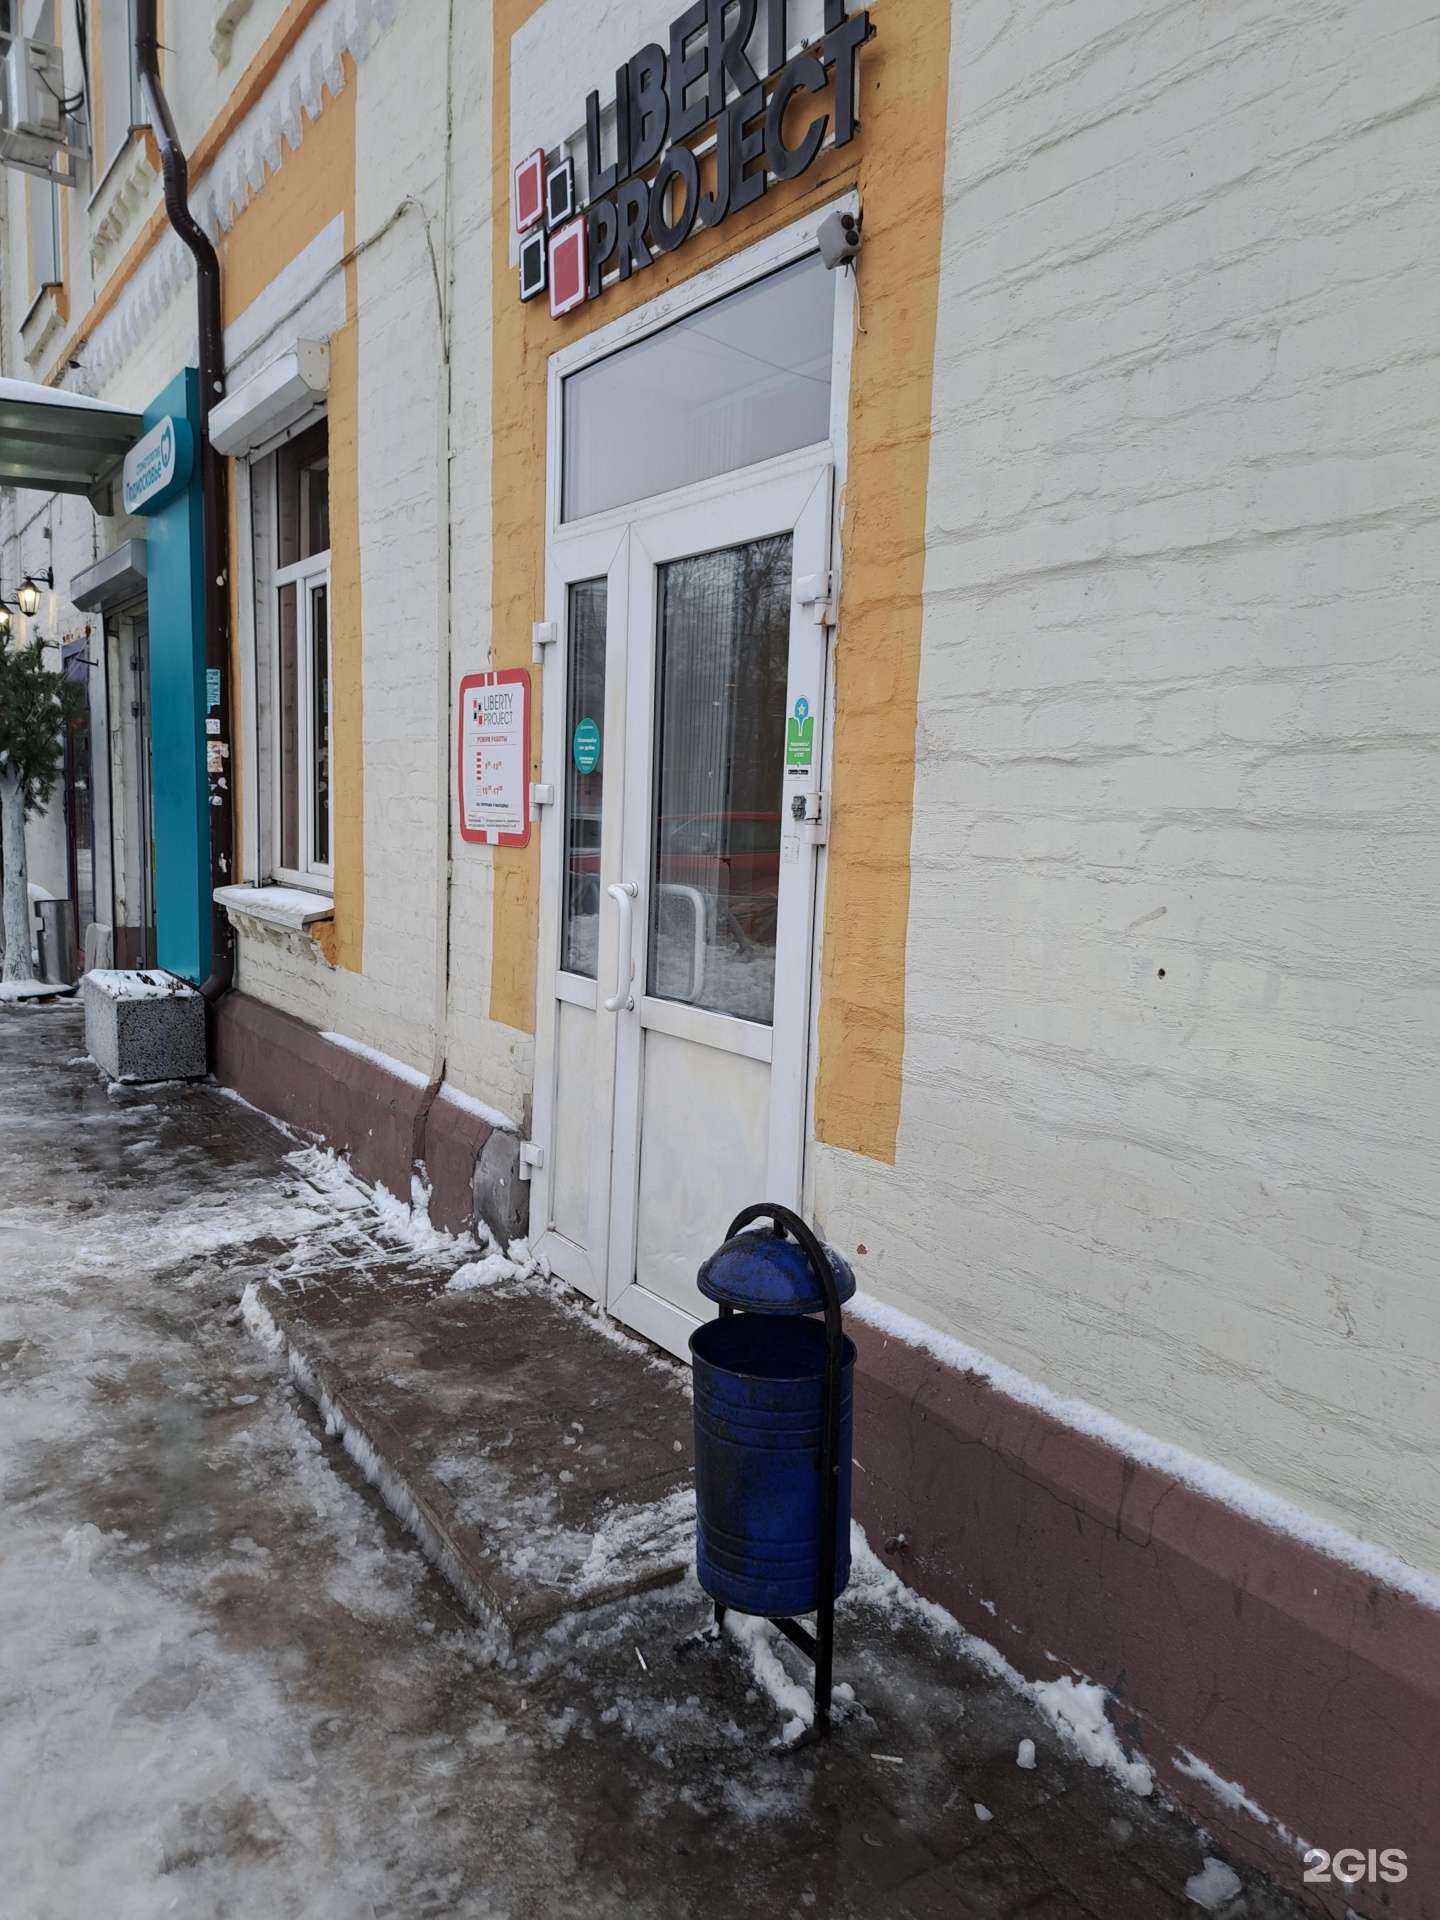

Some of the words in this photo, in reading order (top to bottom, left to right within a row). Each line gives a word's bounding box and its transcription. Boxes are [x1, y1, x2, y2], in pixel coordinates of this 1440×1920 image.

[585, 0, 845, 203] LIBER
[587, 10, 870, 300] PROJECT
[483, 693, 514, 711] LIBERTY
[483, 711, 513, 726] PROJECT
